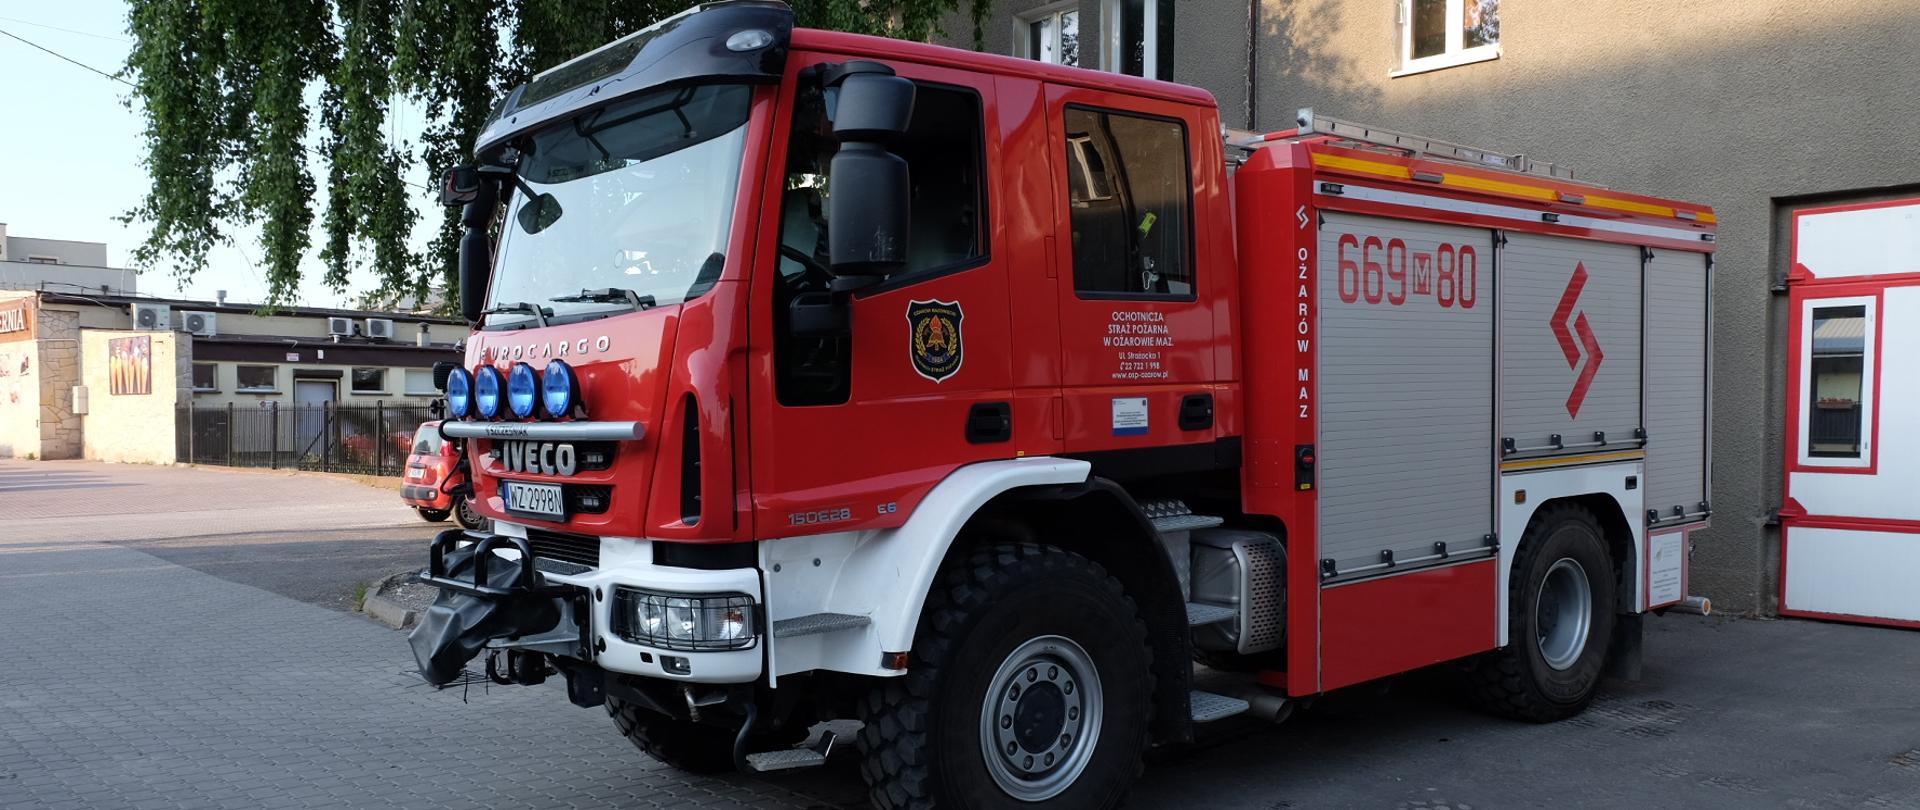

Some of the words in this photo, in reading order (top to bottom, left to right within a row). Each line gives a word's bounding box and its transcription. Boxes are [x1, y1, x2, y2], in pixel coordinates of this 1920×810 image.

[1337, 233, 1407, 306] 669
[1413, 256, 1430, 294] M
[1437, 242, 1476, 309] 80
[1297, 247, 1309, 352] OŻARÓW
[1108, 322, 1131, 334] STRAŻ
[1132, 323, 1169, 334] POŻARNA
[1112, 311, 1164, 321] OCHOTNICZA
[480, 335, 611, 361] EUROCARGO
[1103, 336, 1111, 346] W
[1113, 334, 1154, 347] OŻAROWIE
[1298, 368, 1309, 418] MAZ
[503, 440, 576, 476] IVECO
[510, 484, 526, 509] WZ
[527, 486, 562, 513] 2998N
[788, 508, 850, 525] 150E28
[877, 502, 897, 514] E6
